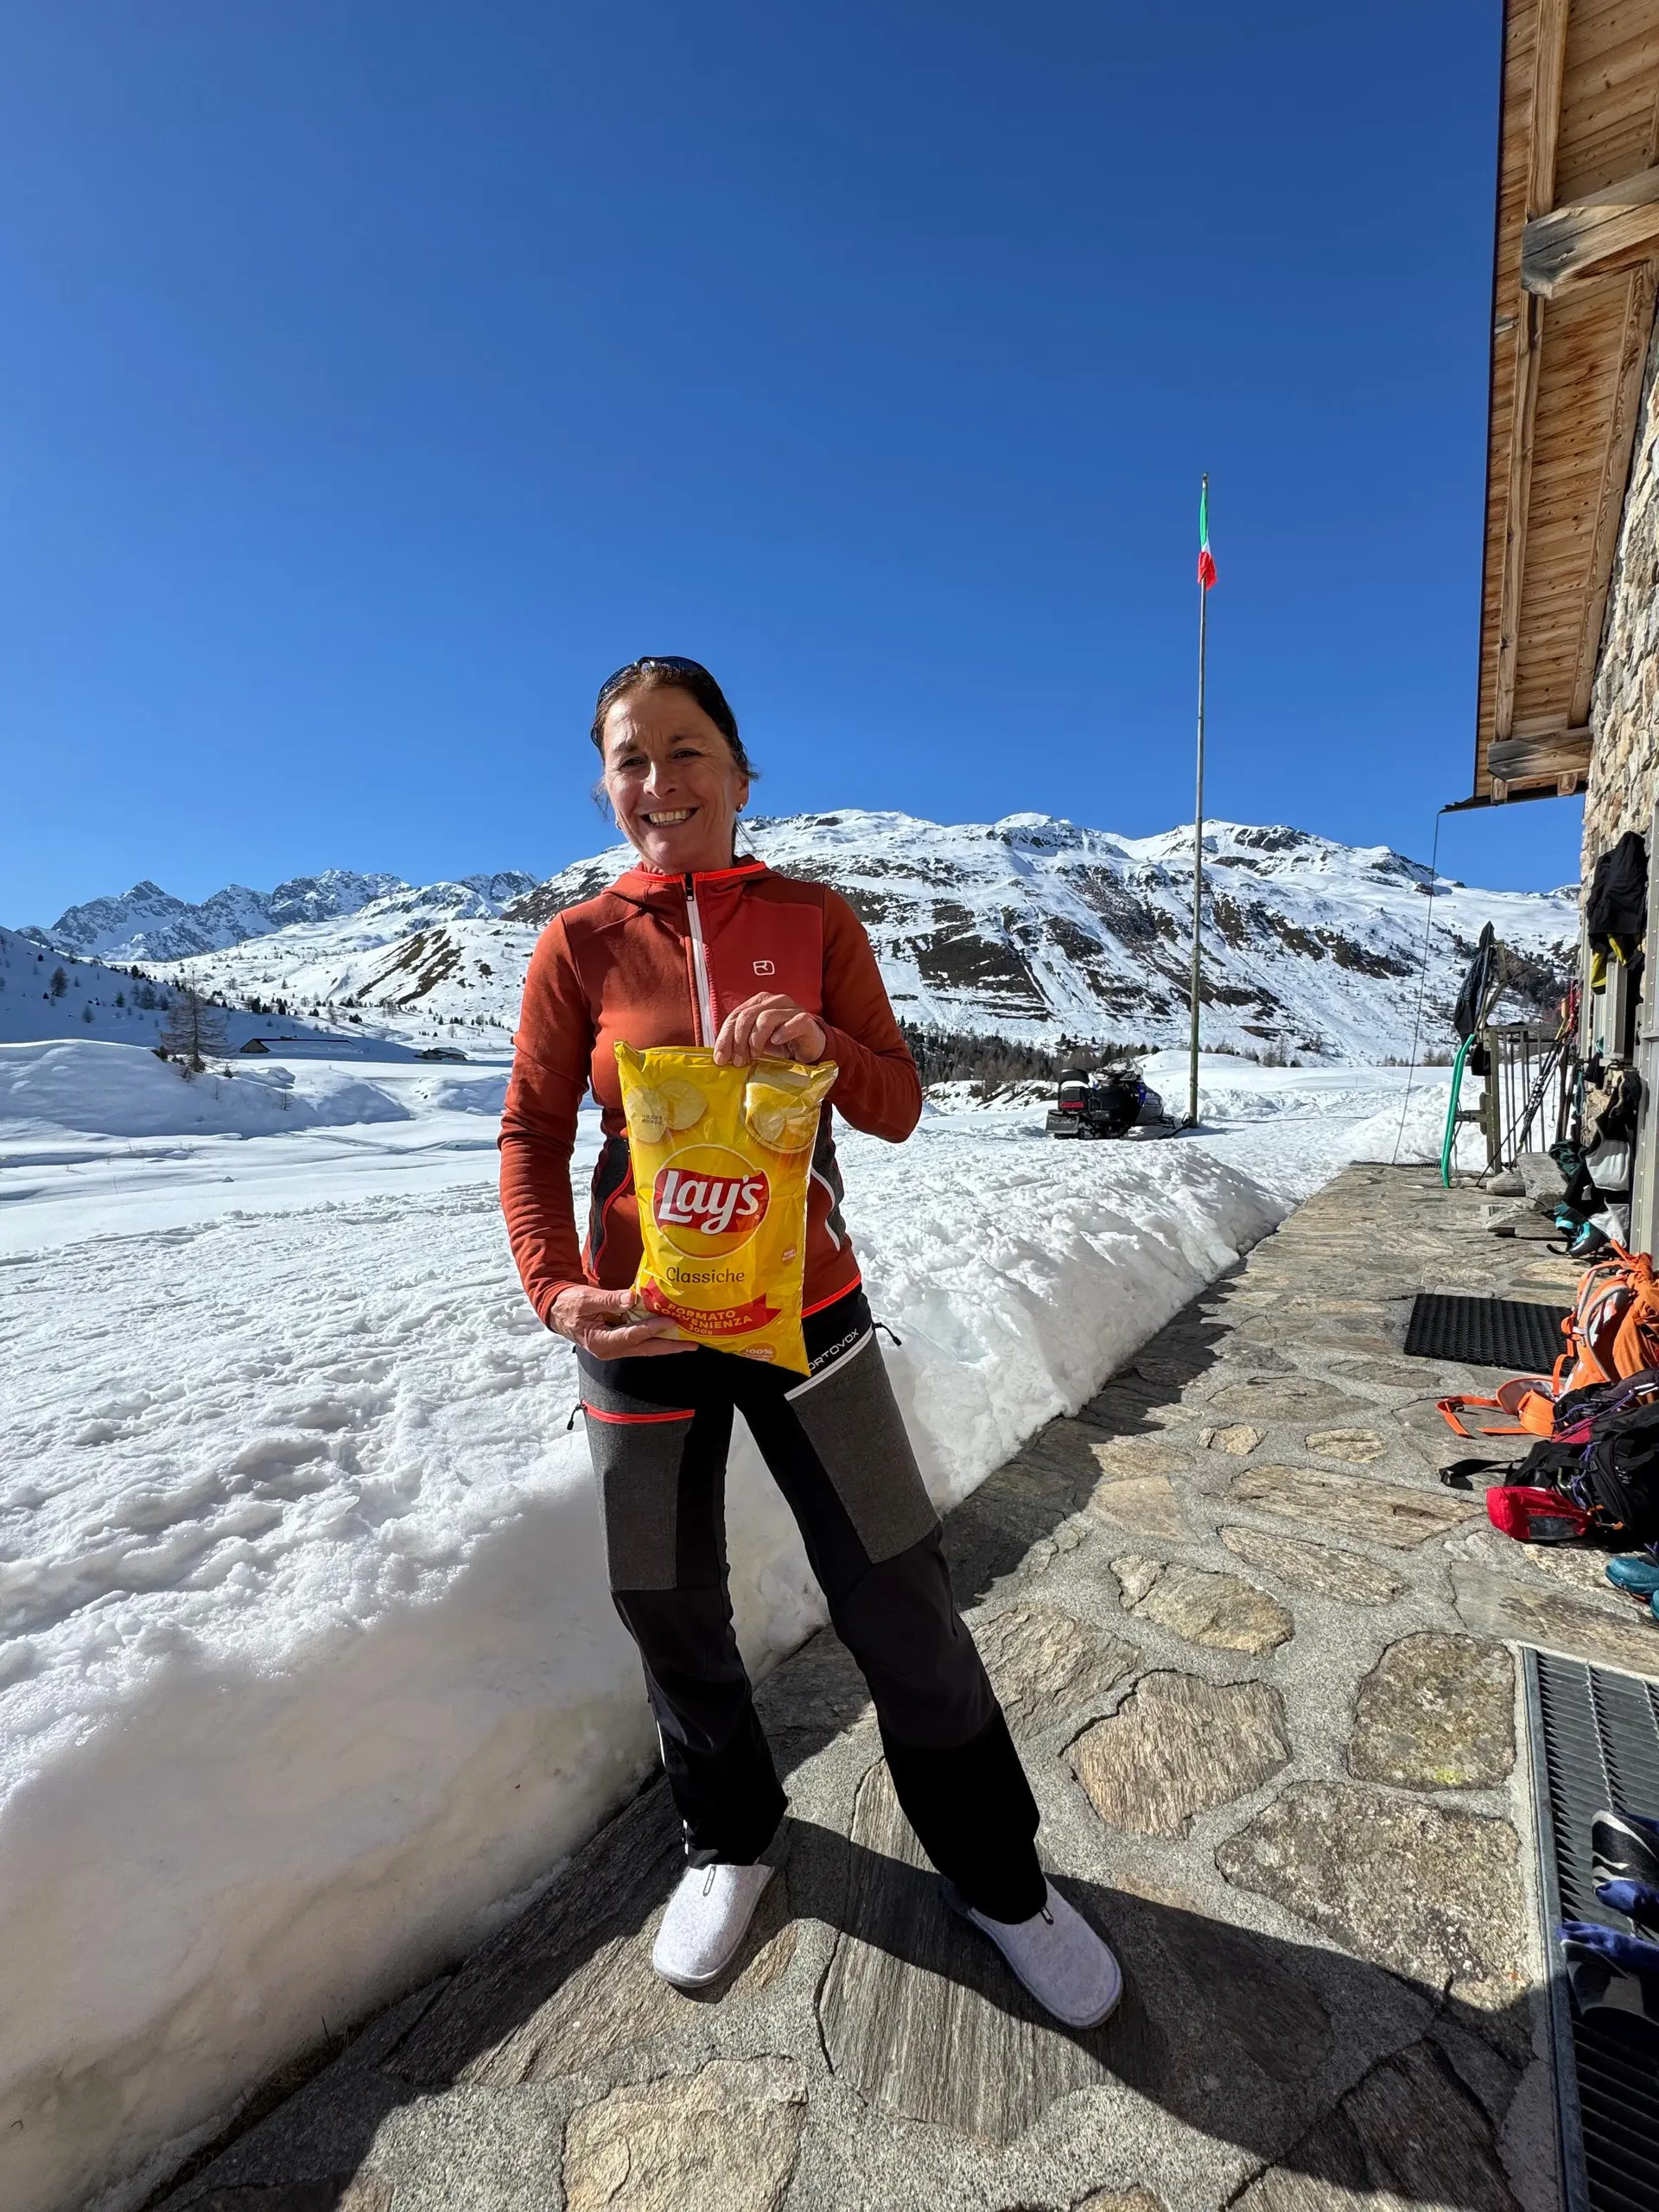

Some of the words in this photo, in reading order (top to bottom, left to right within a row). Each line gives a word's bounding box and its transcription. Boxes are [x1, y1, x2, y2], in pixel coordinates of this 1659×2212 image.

[658, 1170, 763, 1235] Lay's
[666, 1267, 745, 1284] Classiche
[653, 1301, 753, 1329] CONVENIENZA
[668, 1303, 736, 1321] FORMATO
[808, 1328, 859, 1370] ORTOVOX
